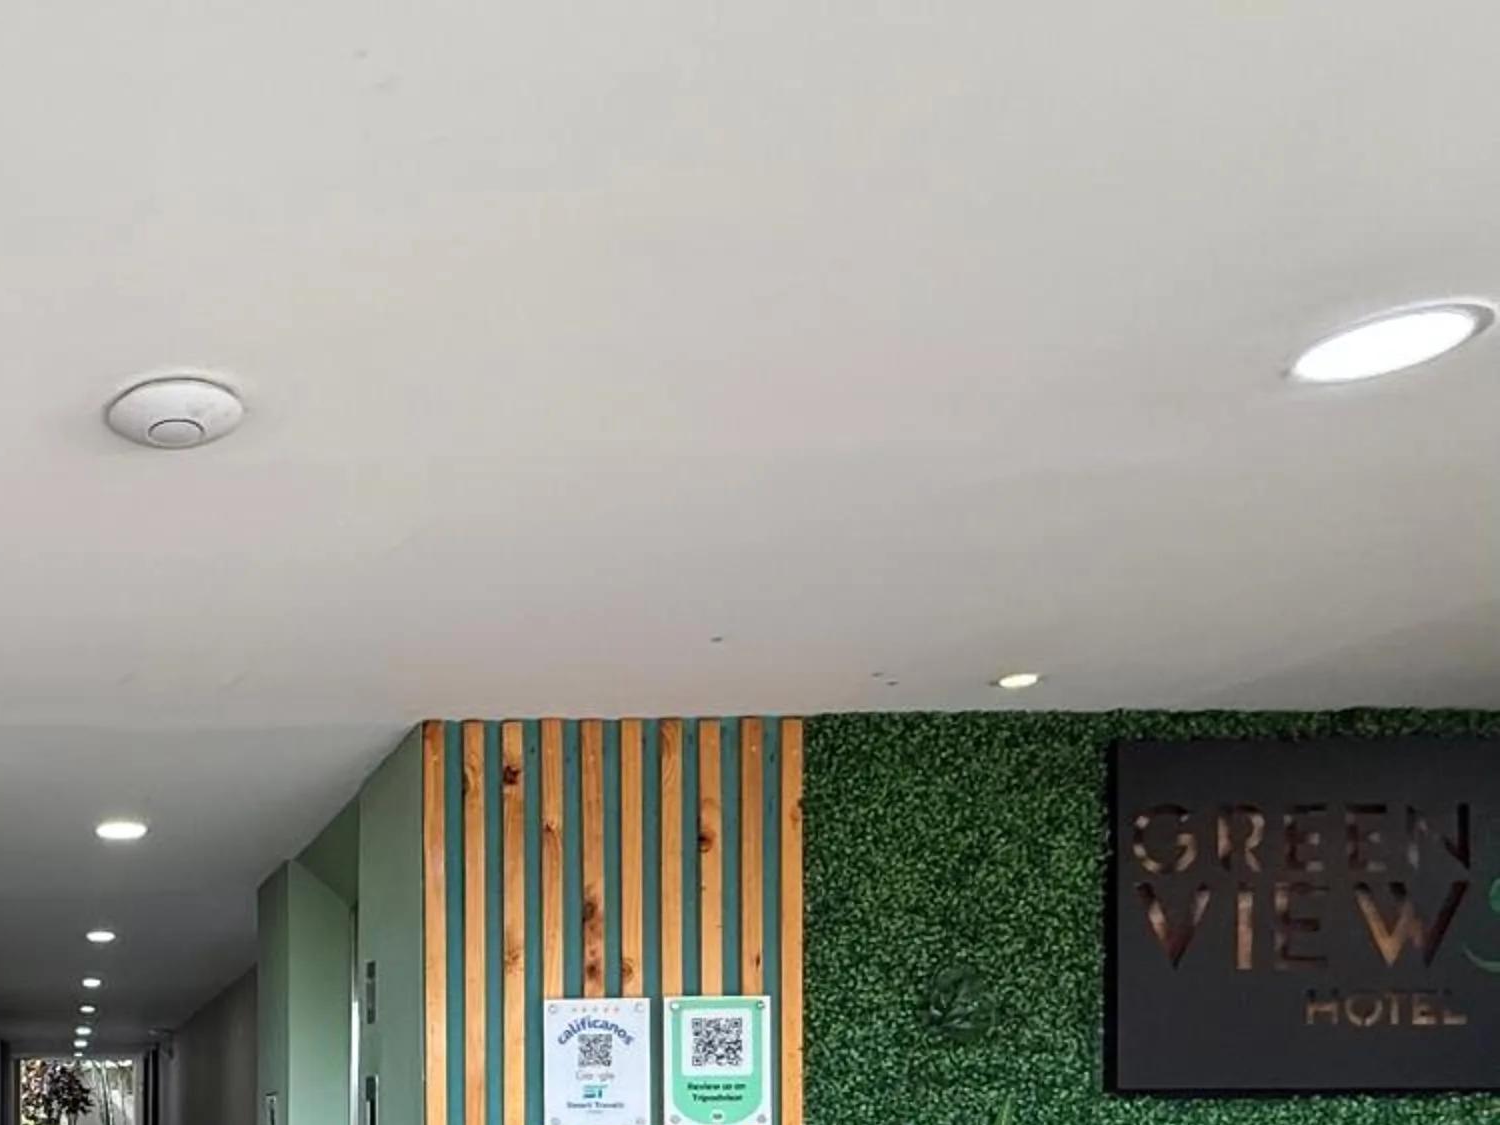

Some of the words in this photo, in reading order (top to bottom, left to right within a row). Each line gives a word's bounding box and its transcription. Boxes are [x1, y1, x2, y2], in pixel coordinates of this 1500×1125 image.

[1132, 803, 1471, 875] GREEN
[1134, 881, 1471, 970] VIEW
[557, 1015, 635, 1046] calificanos
[1306, 989, 1468, 1026] HOTEL
